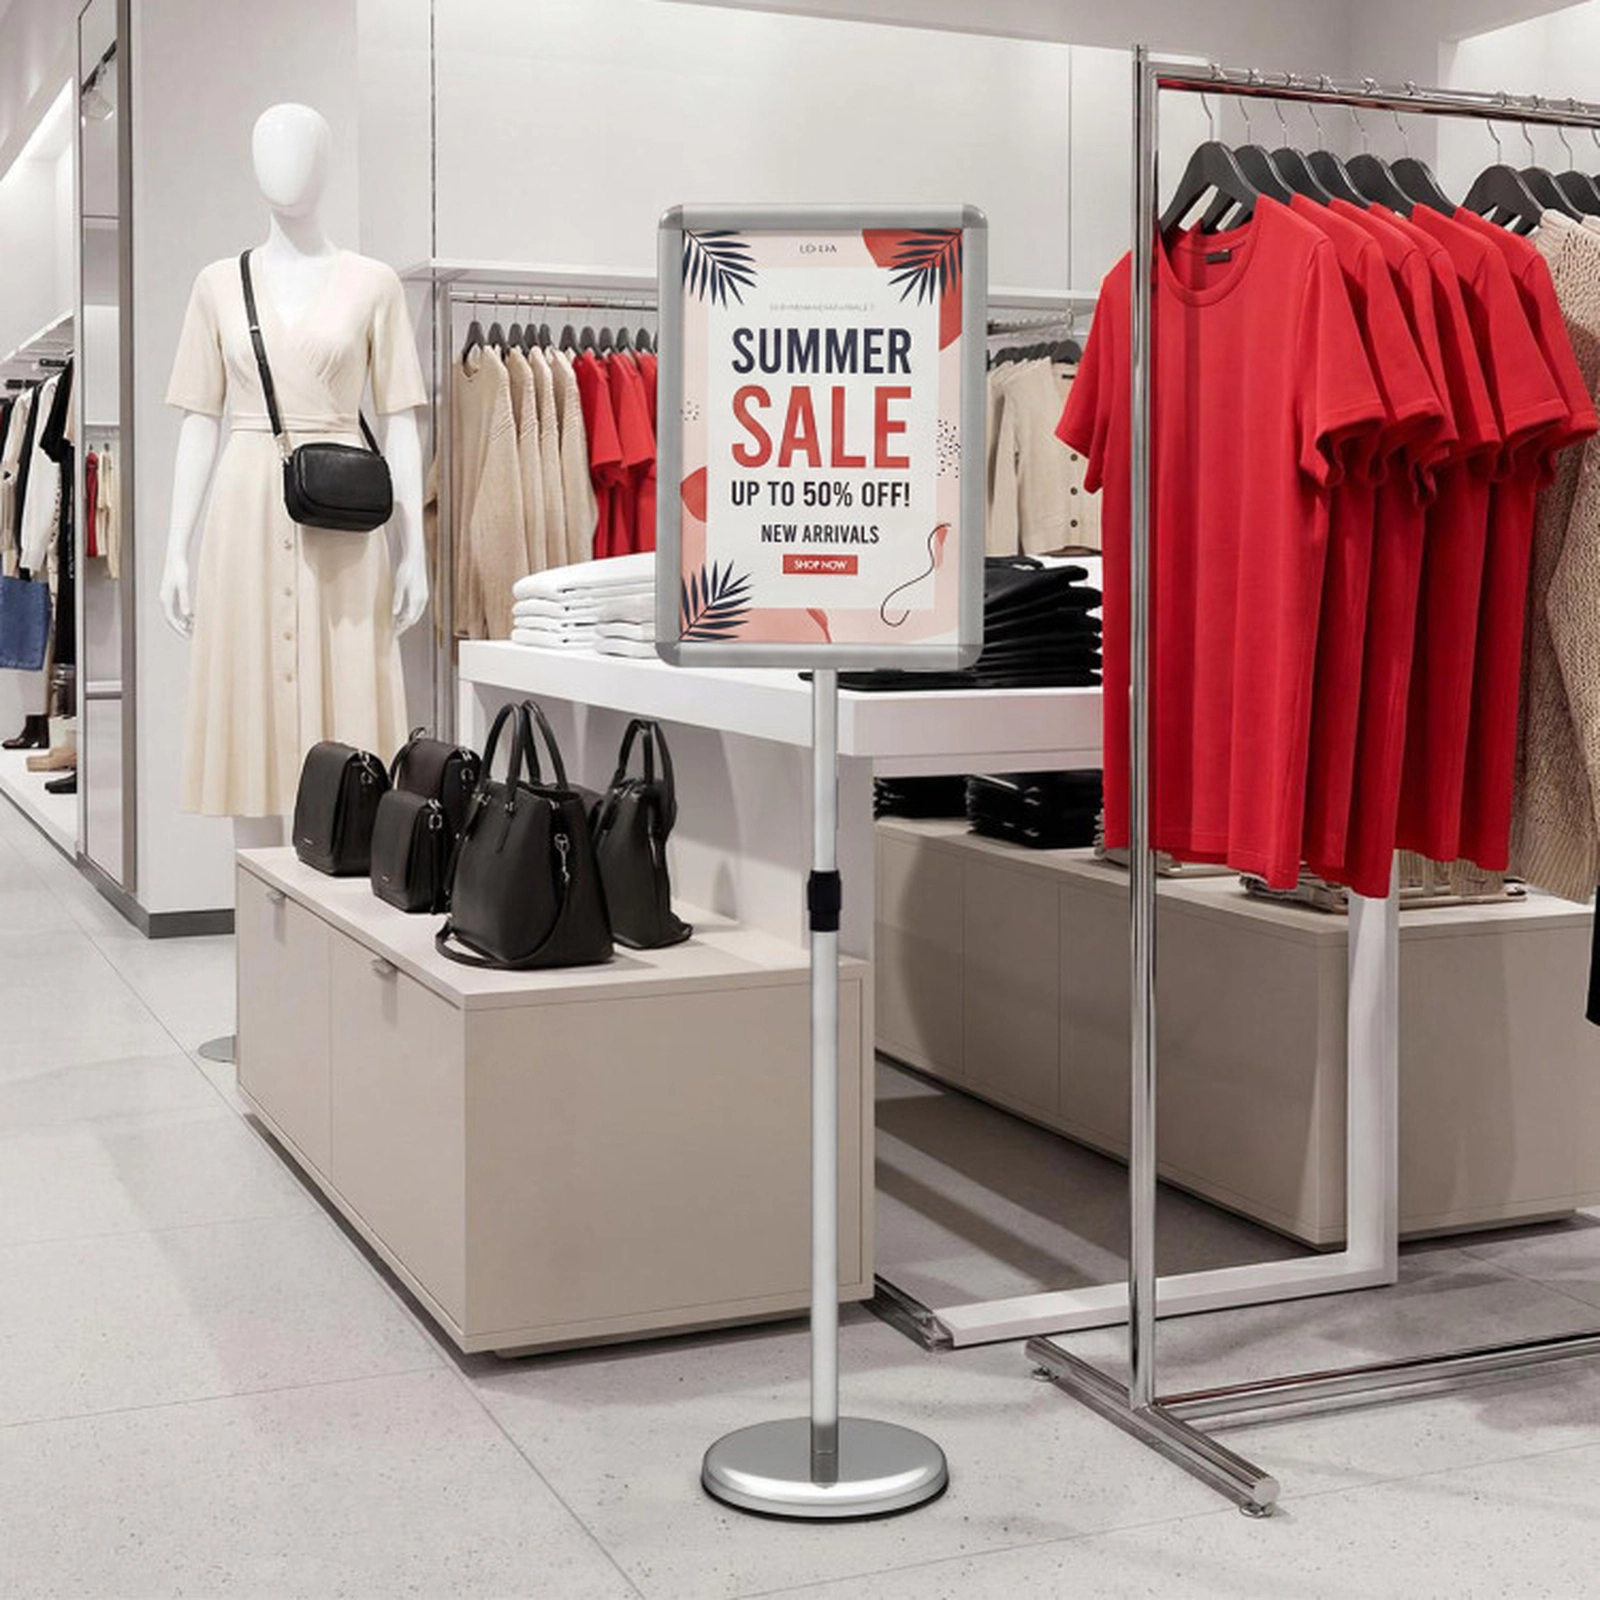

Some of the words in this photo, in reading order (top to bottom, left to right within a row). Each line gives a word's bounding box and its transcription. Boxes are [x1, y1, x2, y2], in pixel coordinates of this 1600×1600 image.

[731, 327, 912, 374] SUMMER
[731, 385, 912, 470] SALE
[731, 480, 760, 506] UP
[767, 481, 795, 506] TO
[803, 481, 853, 507] 50%
[861, 482, 910, 507] OFF!
[761, 524, 797, 543] NEW
[802, 524, 880, 544] ARRIVALS
[793, 560, 820, 570] SHOP
[821, 560, 848, 570] NOW
